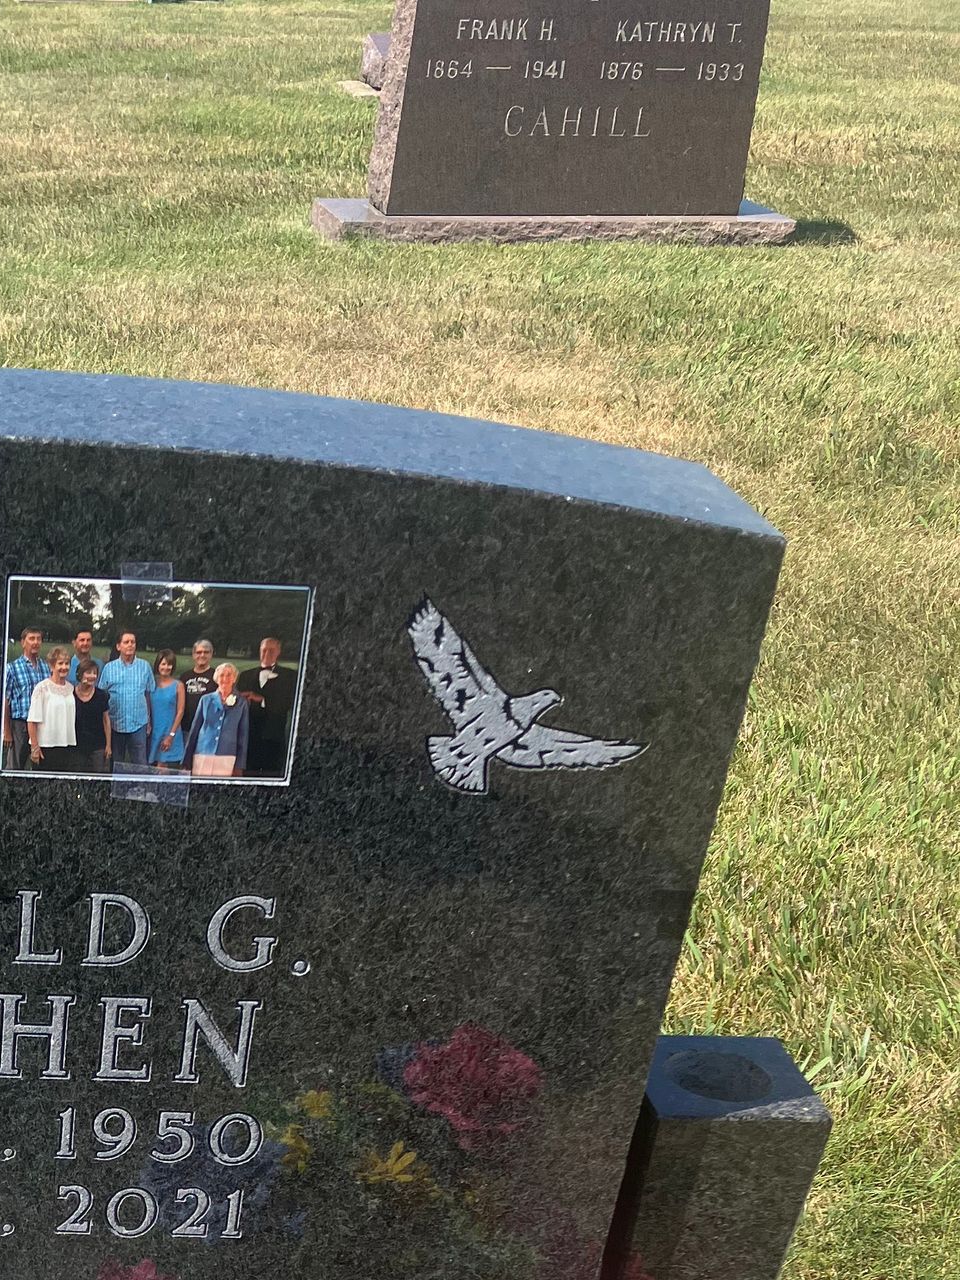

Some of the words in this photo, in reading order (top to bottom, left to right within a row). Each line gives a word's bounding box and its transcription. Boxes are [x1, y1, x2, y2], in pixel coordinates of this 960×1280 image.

[456, 18, 529, 41] FRANK
[539, 19, 558, 41] H.
[615, 19, 716, 43] KATHRYN
[727, 22, 743, 44] T.
[425, 59, 473, 79] 1864
[523, 59, 566, 80] 1941
[599, 61, 644, 80] 1876
[697, 62, 745, 82] 1933
[504, 104, 651, 138] CAHILL
[206, 895, 312, 977] G.
[54, 1106, 265, 1166] 1950
[54, 1184, 245, 1240] 2021
